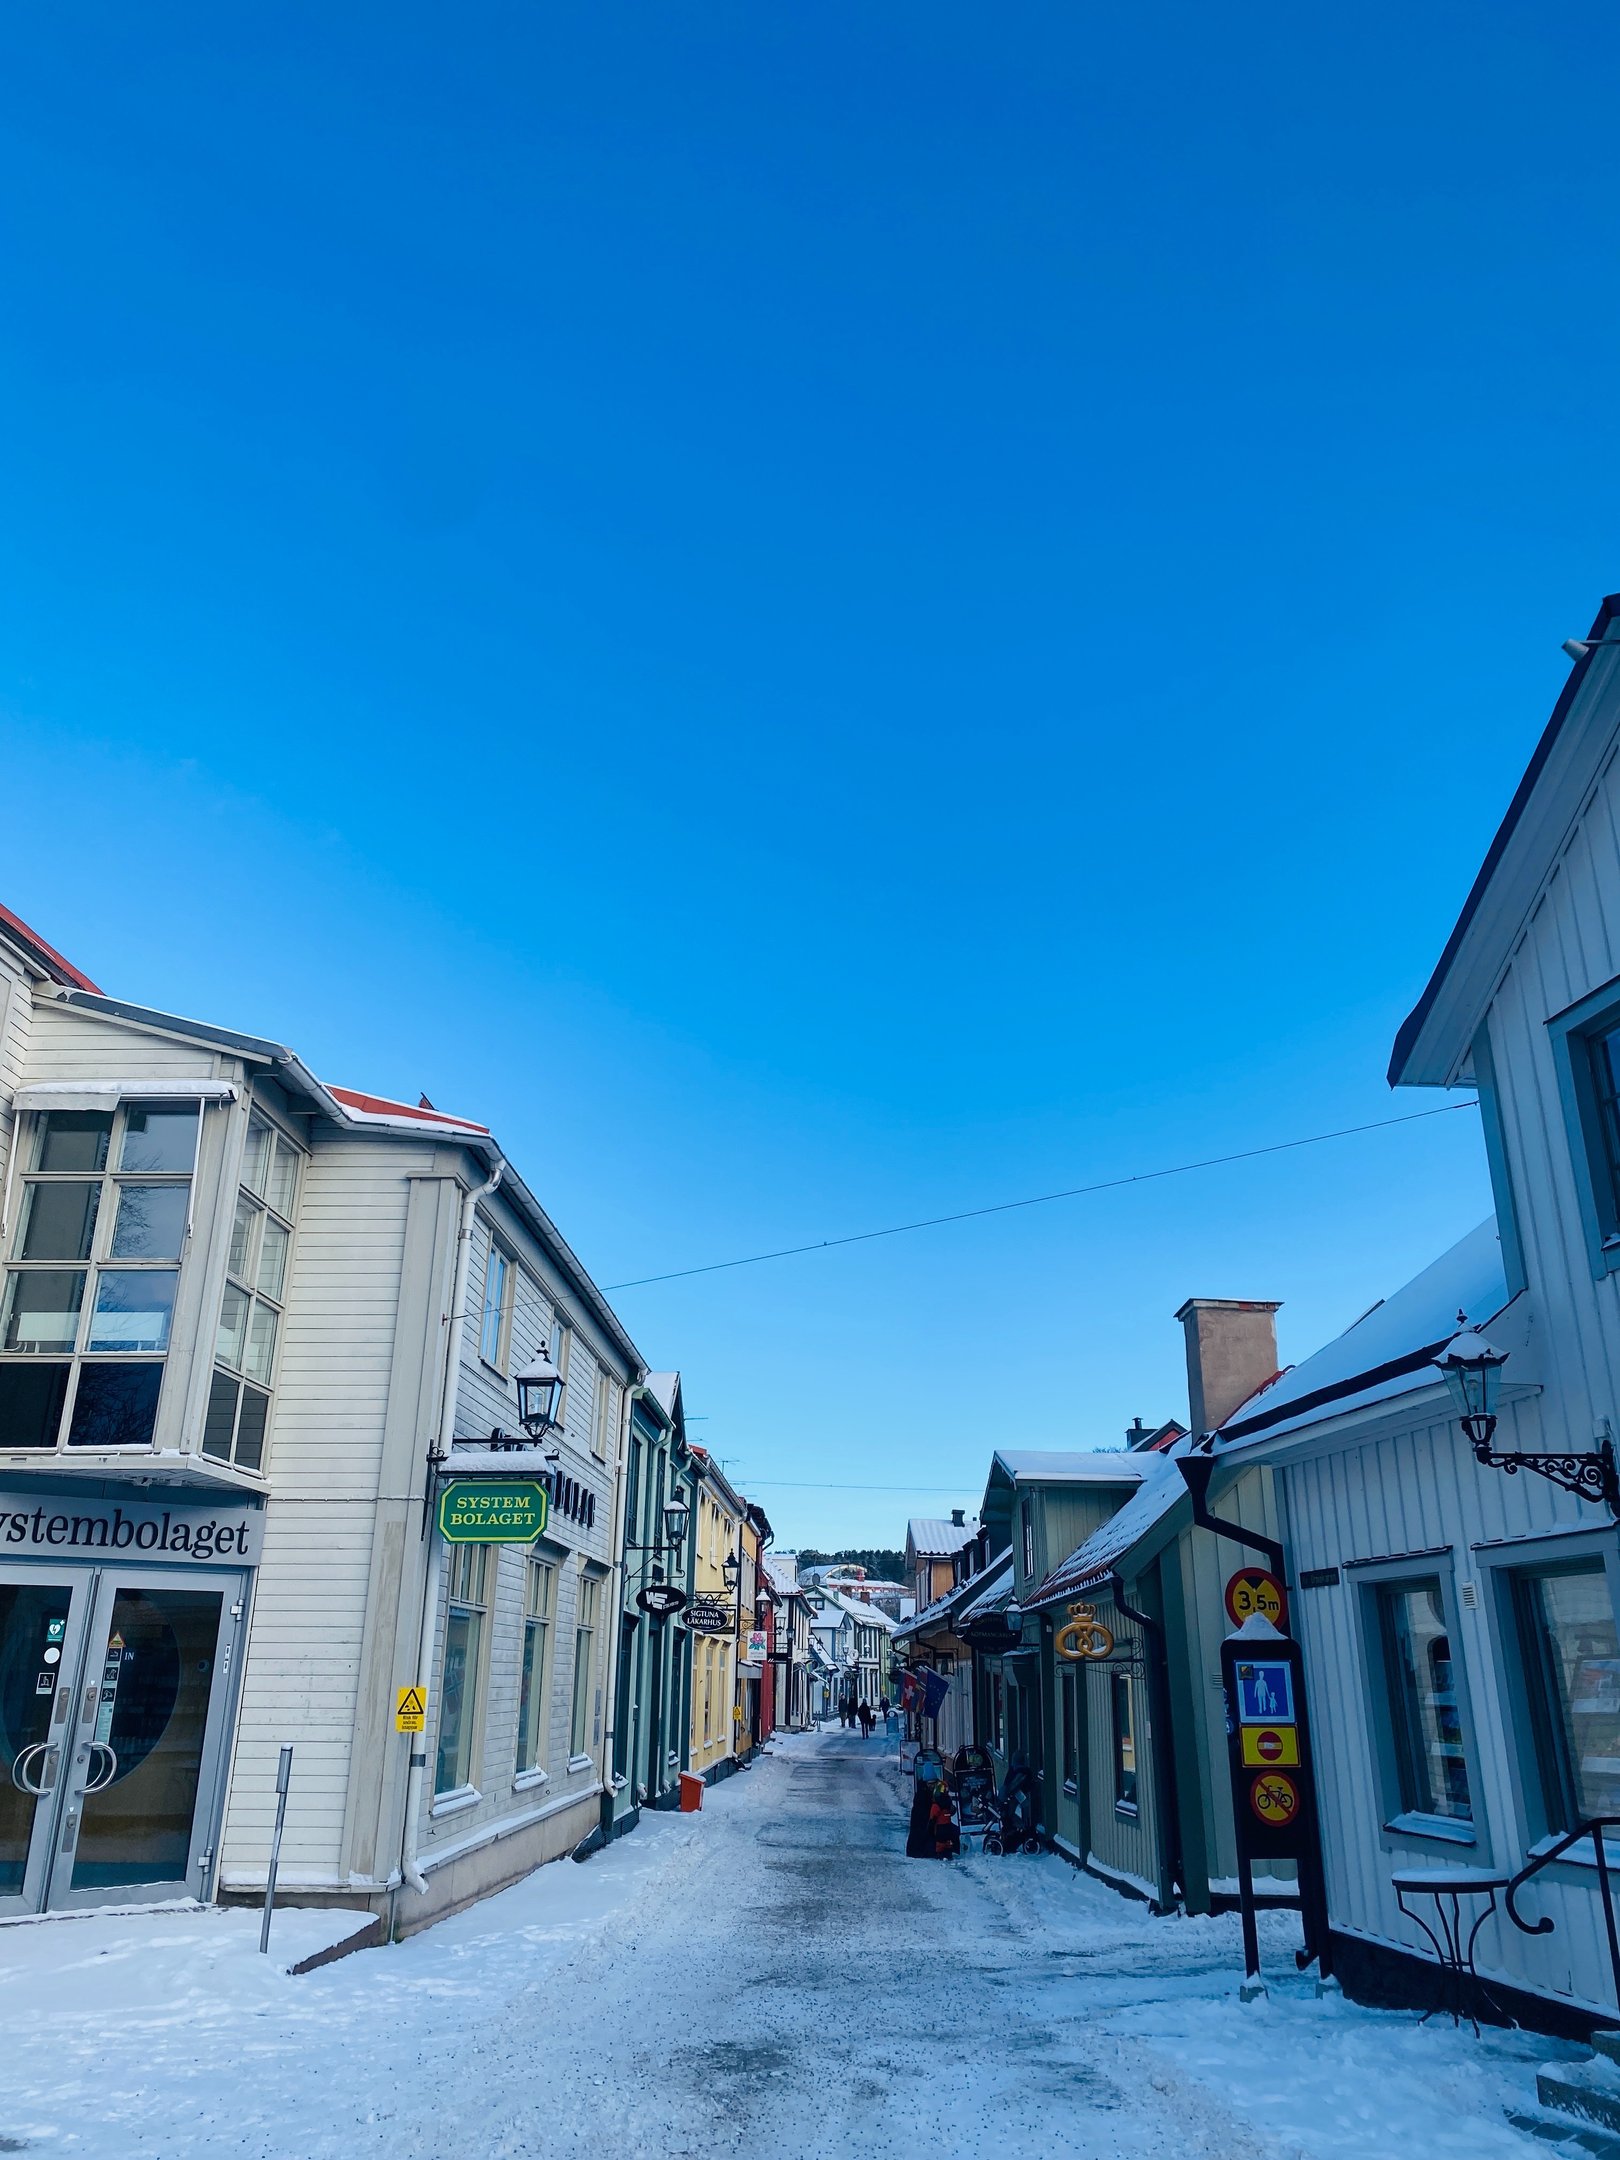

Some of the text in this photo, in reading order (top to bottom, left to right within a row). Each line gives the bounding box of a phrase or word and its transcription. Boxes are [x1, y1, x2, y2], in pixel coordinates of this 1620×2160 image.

[456, 1496, 531, 1509] SYSTEM
[450, 1512, 536, 1525] BOLAGET
[690, 1609, 719, 1618] SIGTUNA
[686, 1617, 722, 1626] LÄKARHUS
